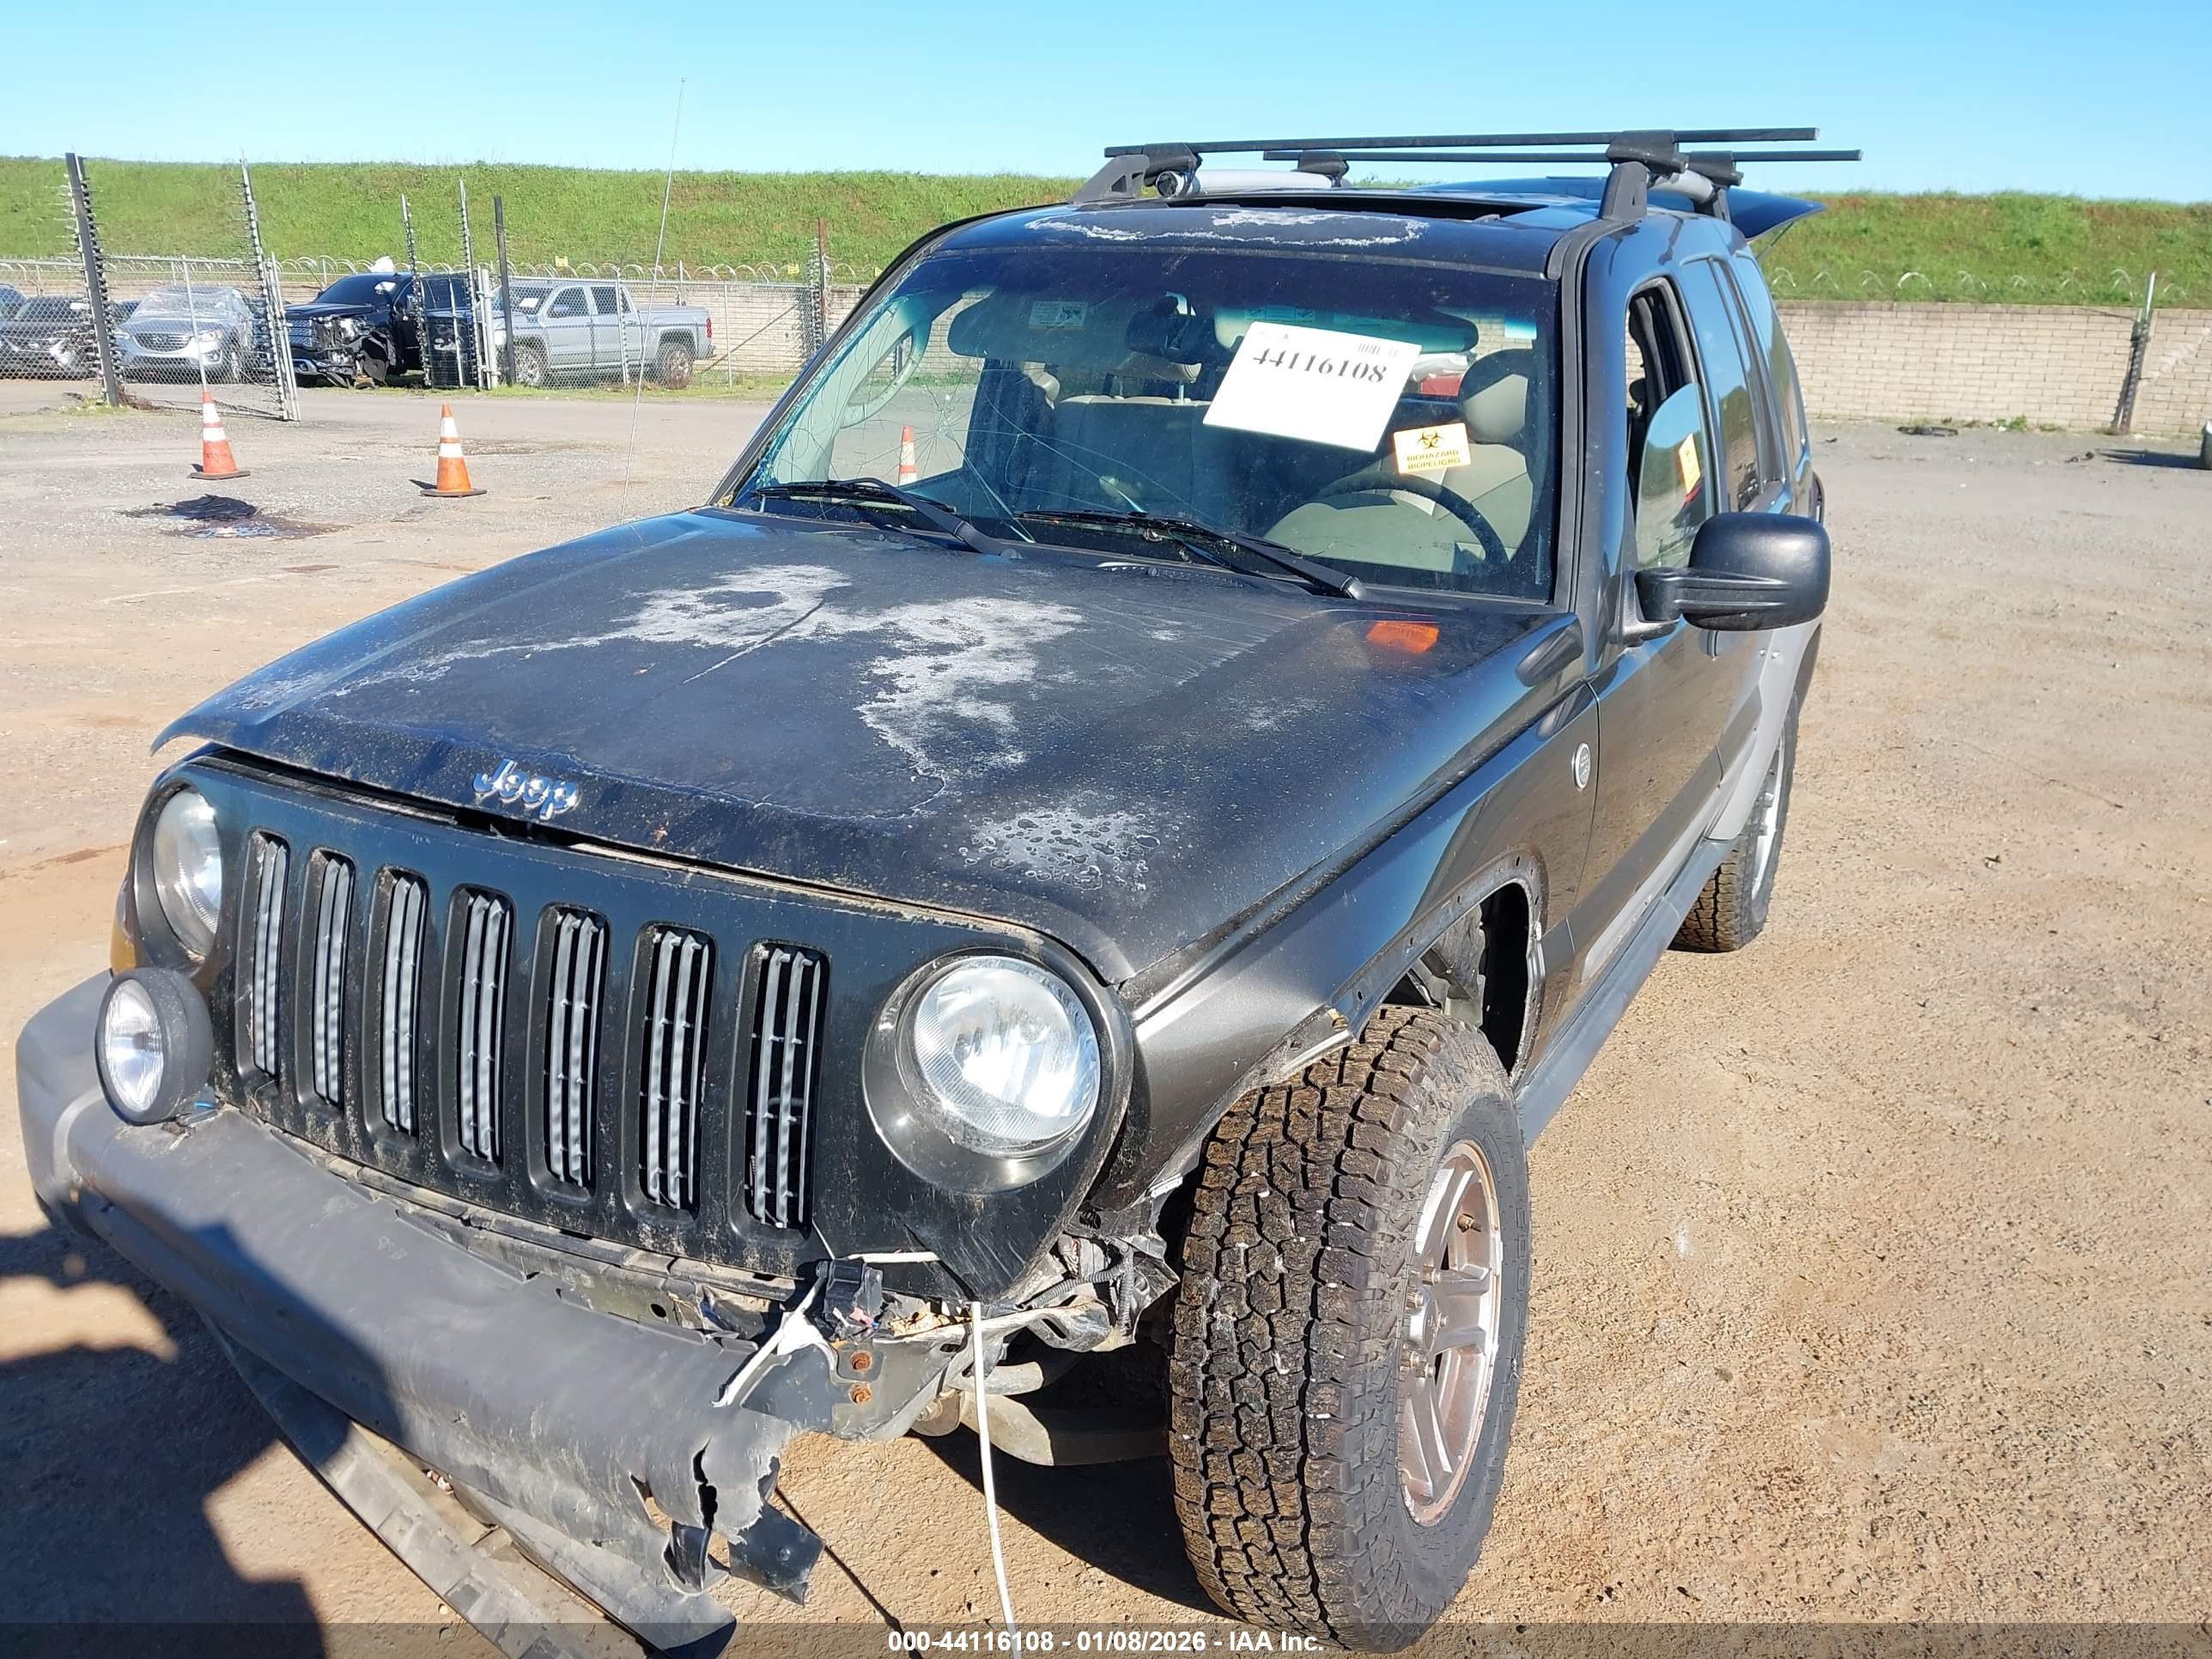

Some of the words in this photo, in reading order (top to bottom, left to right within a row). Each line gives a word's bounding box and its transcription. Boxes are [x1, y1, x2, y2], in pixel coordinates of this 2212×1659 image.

[1253, 348, 1388, 383] 44116108
[1407, 449, 1459, 462] BIOHAZARD
[1407, 458, 1461, 470] BIOPELIGRO
[473, 758, 580, 821] Jeep
